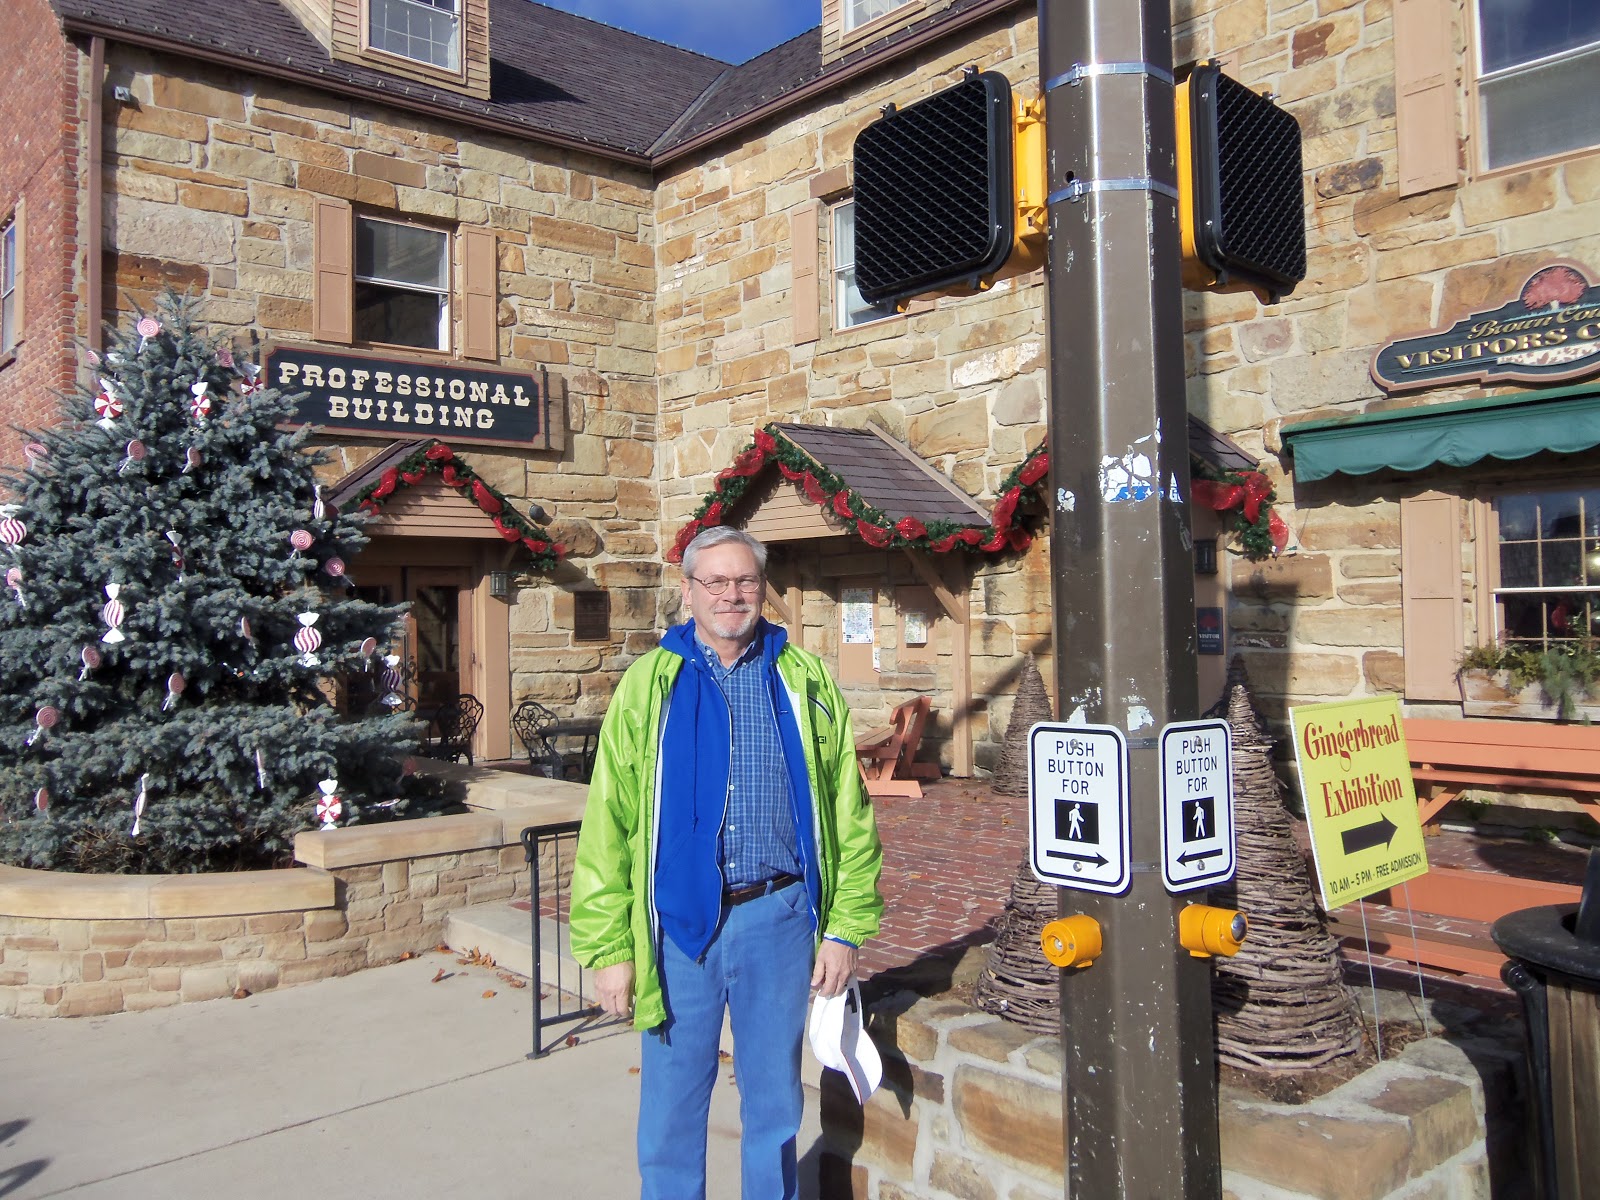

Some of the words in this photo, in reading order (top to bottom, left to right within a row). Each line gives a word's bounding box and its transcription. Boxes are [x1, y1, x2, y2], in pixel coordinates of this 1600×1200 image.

[1467, 316, 1553, 340] Brown
[1395, 328, 1568, 369] VISITORS
[279, 362, 530, 407] PROFESSIONAL
[329, 396, 495, 429] BUILDING
[1056, 740, 1094, 757] PUSH
[1182, 737, 1211, 755] PUSH
[1303, 714, 1400, 772] Gingerbread
[1048, 759, 1104, 777] BUTTON
[1176, 756, 1217, 775] BUTTON
[1062, 779, 1089, 795] FOR
[1187, 776, 1208, 793] FOR
[1320, 773, 1403, 818] Exhibition
[1329, 881, 1338, 895] 10
[1339, 876, 1351, 892] AM
[1355, 872, 1361, 886] 5
[1361, 869, 1373, 884] PM
[1375, 863, 1390, 879] FREE
[1390, 853, 1422, 873] ADMISSION
